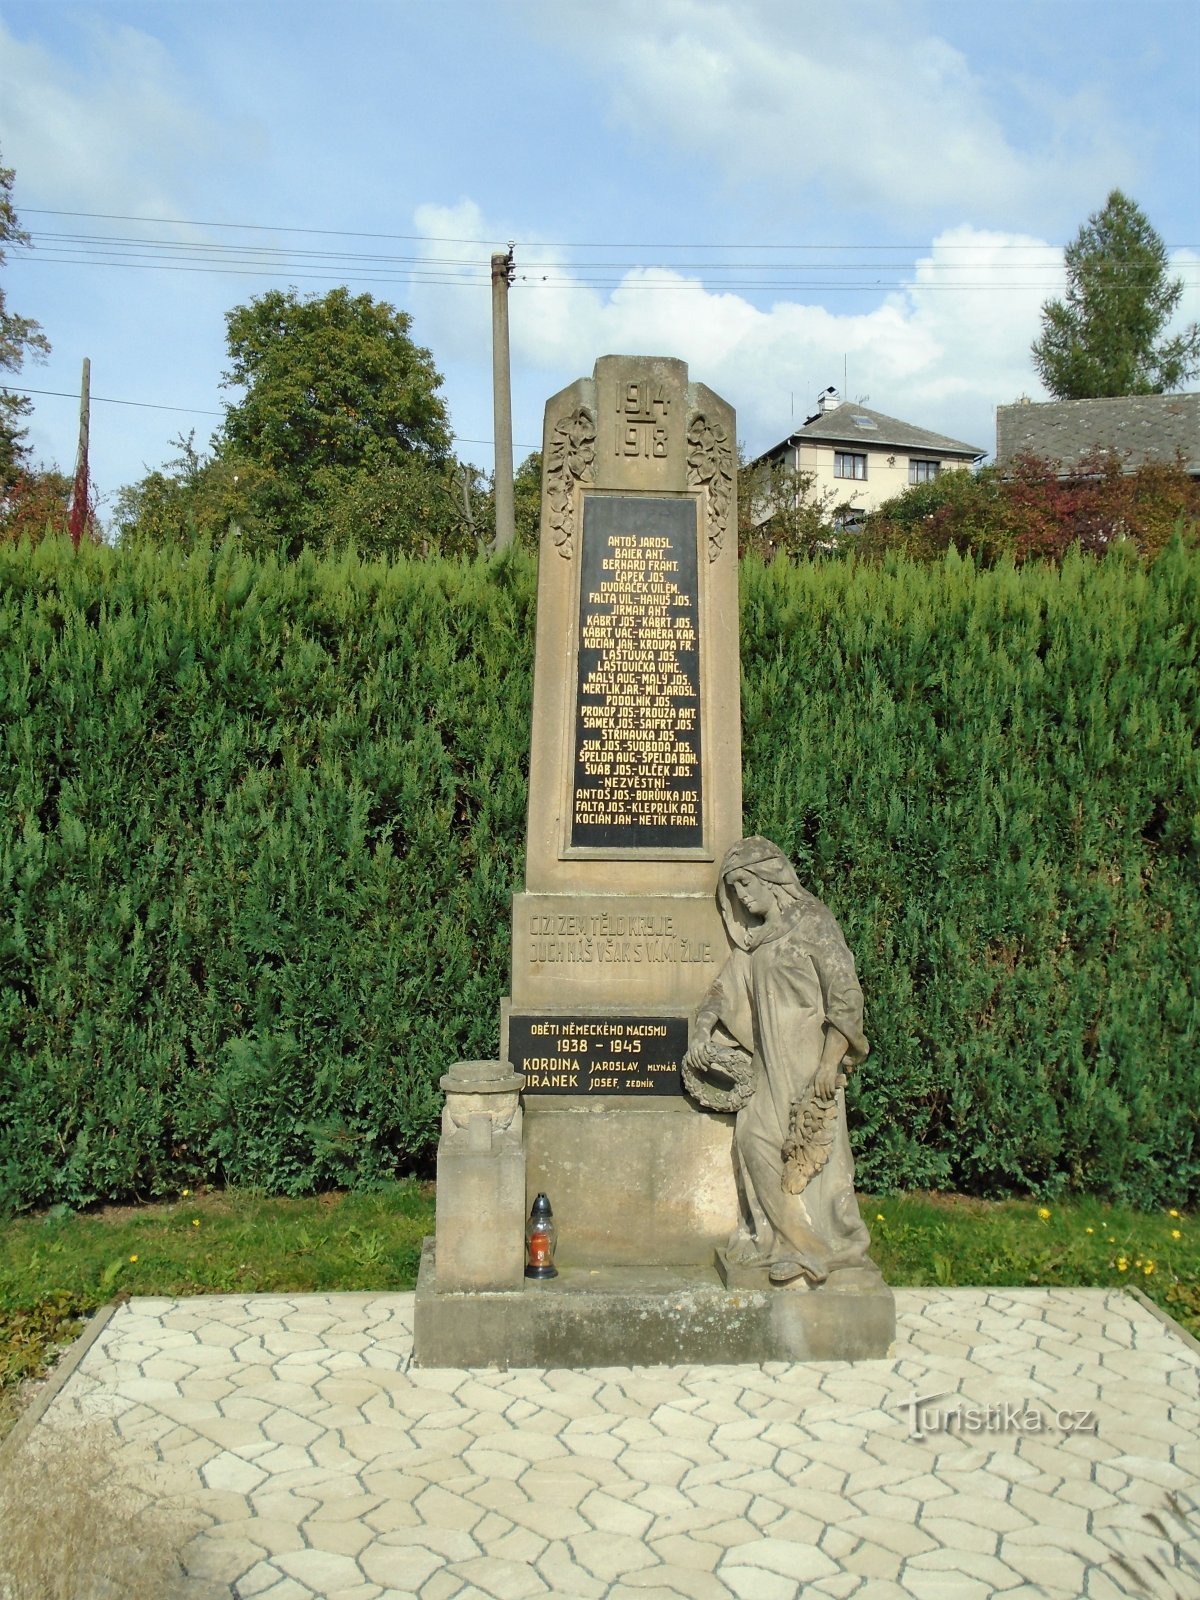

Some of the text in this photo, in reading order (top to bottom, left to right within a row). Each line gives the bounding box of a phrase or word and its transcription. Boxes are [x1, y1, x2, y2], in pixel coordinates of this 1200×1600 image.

[616, 382, 670, 415] 1914
[615, 424, 668, 458] 1918
[608, 535, 673, 548] ANTOŠ JAROSL.
[615, 549, 666, 559] BAIER ANT.
[603, 559, 679, 571] BERNARD FRANT.
[615, 570, 644, 582] ČAPEK
[589, 593, 616, 603] FALTA
[673, 596, 692, 606] JOS.
[611, 605, 669, 616] JIRMAN ANT.
[587, 613, 617, 626] KÁBRT
[673, 618, 693, 628] JOS.
[583, 626, 612, 637] KÁBRT
[676, 630, 696, 640] KAR.
[585, 637, 614, 648] KOCIÁN
[680, 641, 694, 651] FR.
[658, 651, 677, 661] JOS.
[598, 660, 682, 673] LAŠTOVIČKA VINC.
[589, 671, 614, 683] MALÝ
[671, 675, 690, 685] JOS.
[583, 682, 620, 694] MERTLÍK
[661, 686, 696, 696] JAROSL.
[607, 694, 673, 707] PODOLNÍK JOS.
[581, 706, 616, 716] PROKOP
[679, 709, 696, 719] ANT.
[584, 718, 614, 728] SAMEK
[675, 720, 694, 730] JOS.
[658, 731, 677, 741] JOS.
[583, 741, 601, 750] SUK
[673, 742, 692, 752] JOS.
[579, 749, 614, 762] ŠPELDA
[680, 754, 698, 764] BOH.
[585, 763, 610, 775] ŠVÁB
[673, 766, 692, 776] JOS.
[576, 788, 610, 799] ANTOŠ
[681, 791, 699, 801] JOS.
[576, 801, 605, 811] FALTA
[681, 804, 698, 813] AD.
[576, 812, 611, 824] KOCIÁN
[670, 816, 698, 825] FRAN.
[558, 916, 586, 935] ZEM
[591, 913, 624, 936] TĚLO
[629, 917, 677, 938] KRYJE,
[530, 942, 563, 962] DUCH
[568, 939, 592, 962] NÁŠ
[597, 939, 631, 962] VŠAK
[634, 945, 642, 962] S
[646, 939, 677, 962] VÁMI
[531, 1022, 666, 1036] OBĚTI NĚMECKÉHO NACISMU
[557, 1040, 588, 1052] 1938
[610, 1040, 641, 1052] 1945
[523, 1058, 677, 1074] KORDINA JAROSLAV, MLYNÁŘ
[626, 1078, 654, 1088] ZEDNÍK
